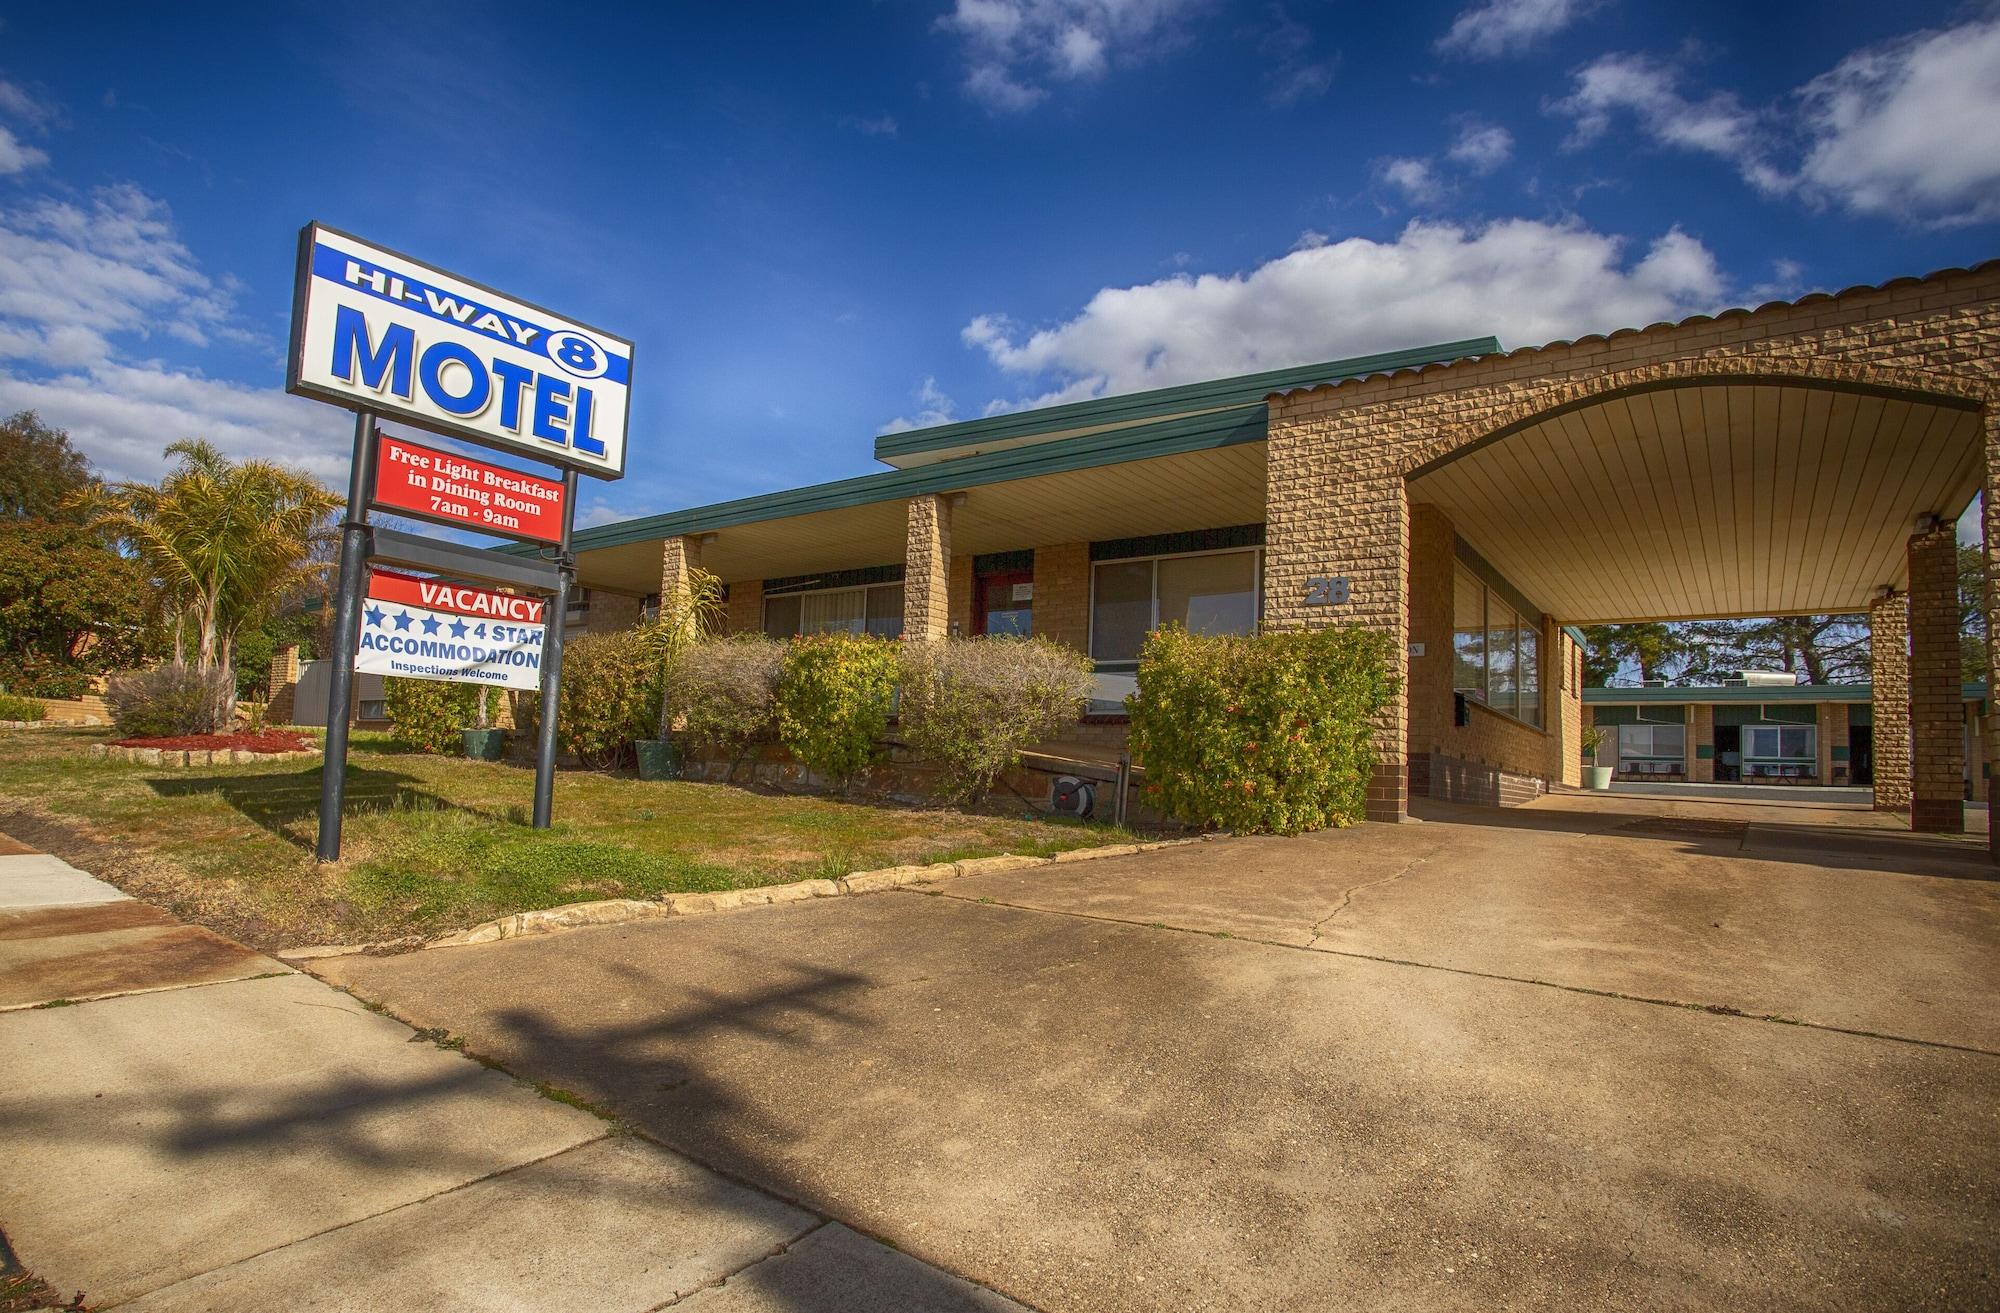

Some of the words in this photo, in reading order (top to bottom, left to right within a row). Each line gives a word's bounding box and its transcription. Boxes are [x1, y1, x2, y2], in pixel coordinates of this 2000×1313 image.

[345, 261, 538, 346] HI-WAY
[557, 337, 597, 371] 8
[331, 304, 607, 459] MOTEL
[389, 446, 430, 468] Free
[434, 457, 479, 482] Light
[483, 470, 559, 502] Breakfast
[407, 469, 427, 488] in
[431, 476, 490, 506] Dining
[494, 492, 541, 516] Room
[430, 495, 469, 517] 7am
[483, 508, 519, 529] 9am
[419, 581, 543, 622] VACANCY
[1303, 576, 1350, 605] 28
[360, 632, 540, 669] ACCOMMODATION
[473, 623, 487, 639] 4
[491, 625, 543, 646] STAR
[391, 660, 458, 677] Inspections
[461, 668, 508, 681] Welcome
